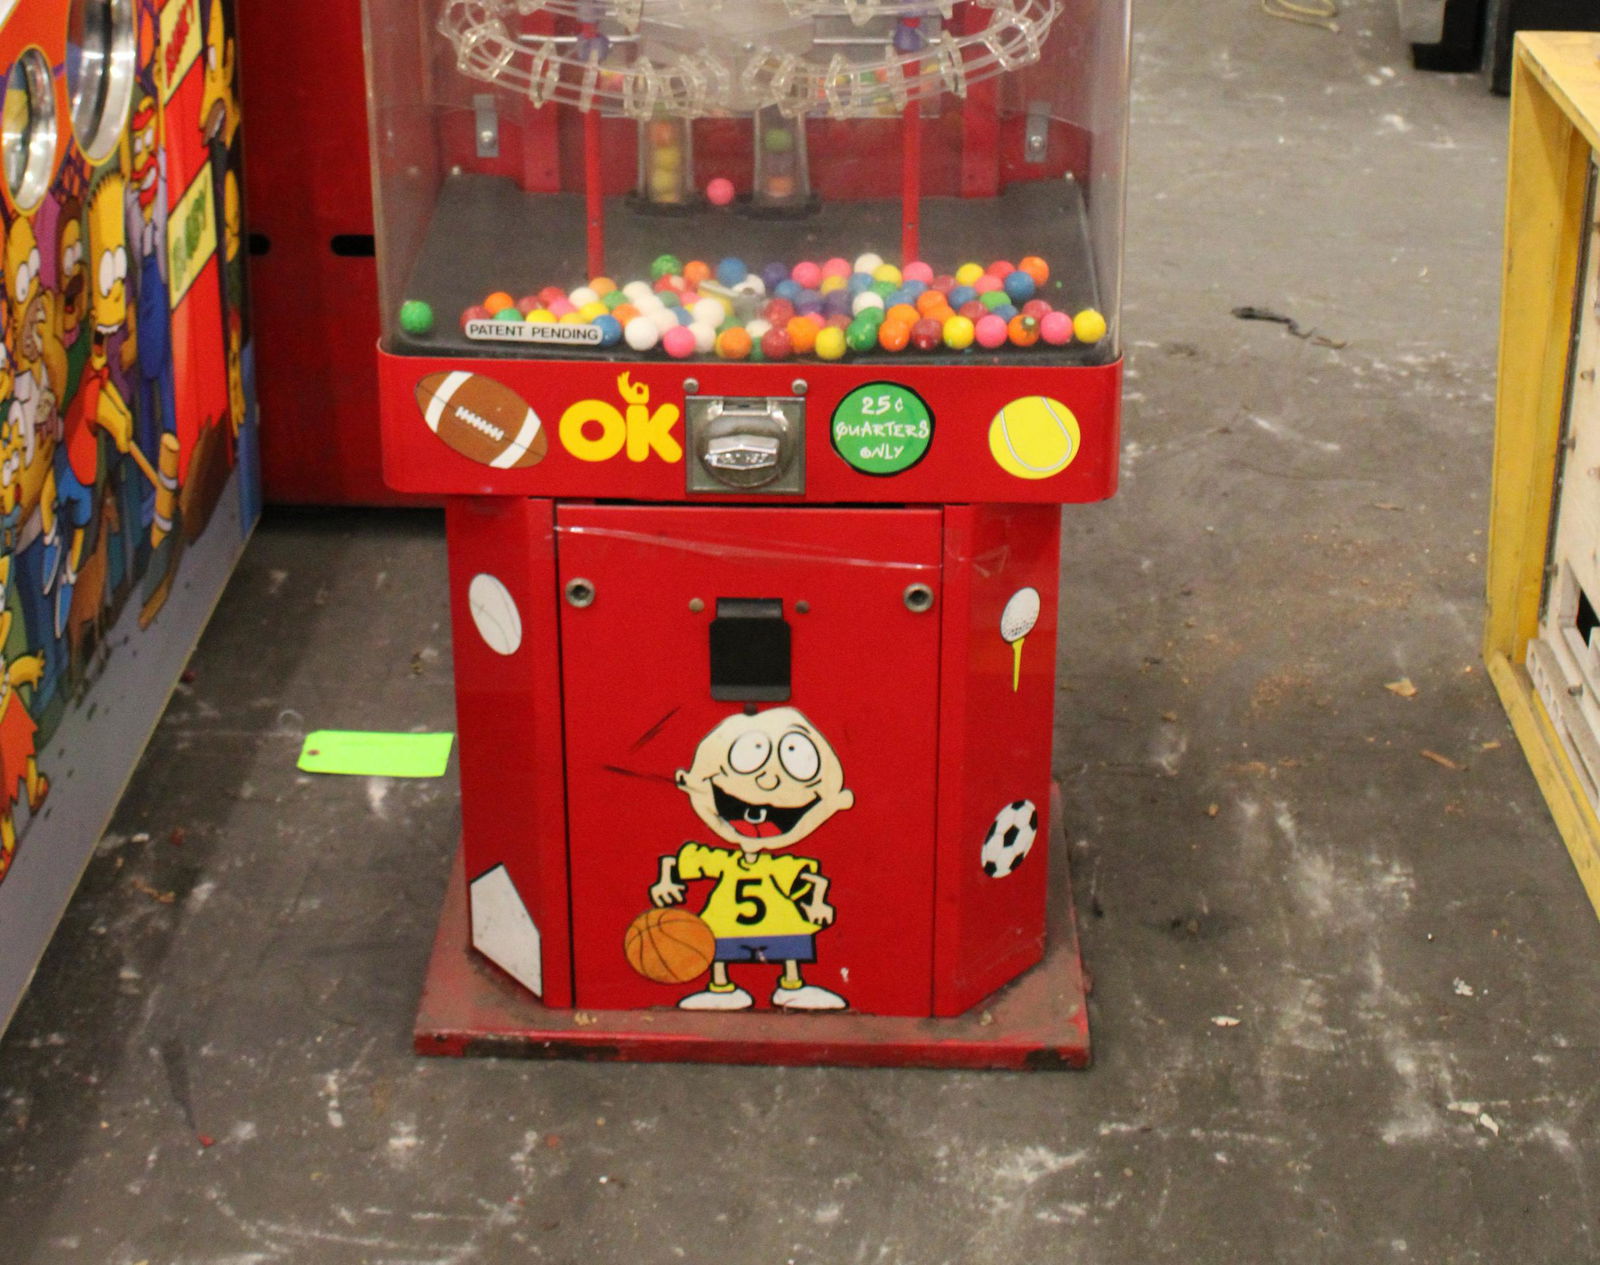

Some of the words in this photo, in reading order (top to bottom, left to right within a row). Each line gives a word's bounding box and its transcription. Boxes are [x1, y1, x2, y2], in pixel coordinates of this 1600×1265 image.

[469, 323, 524, 337] PATENT
[532, 326, 599, 341] PENDING
[558, 399, 683, 463] OK
[836, 419, 929, 441] QUARTERS
[860, 442, 904, 460] ONLY
[733, 878, 767, 926] 5
